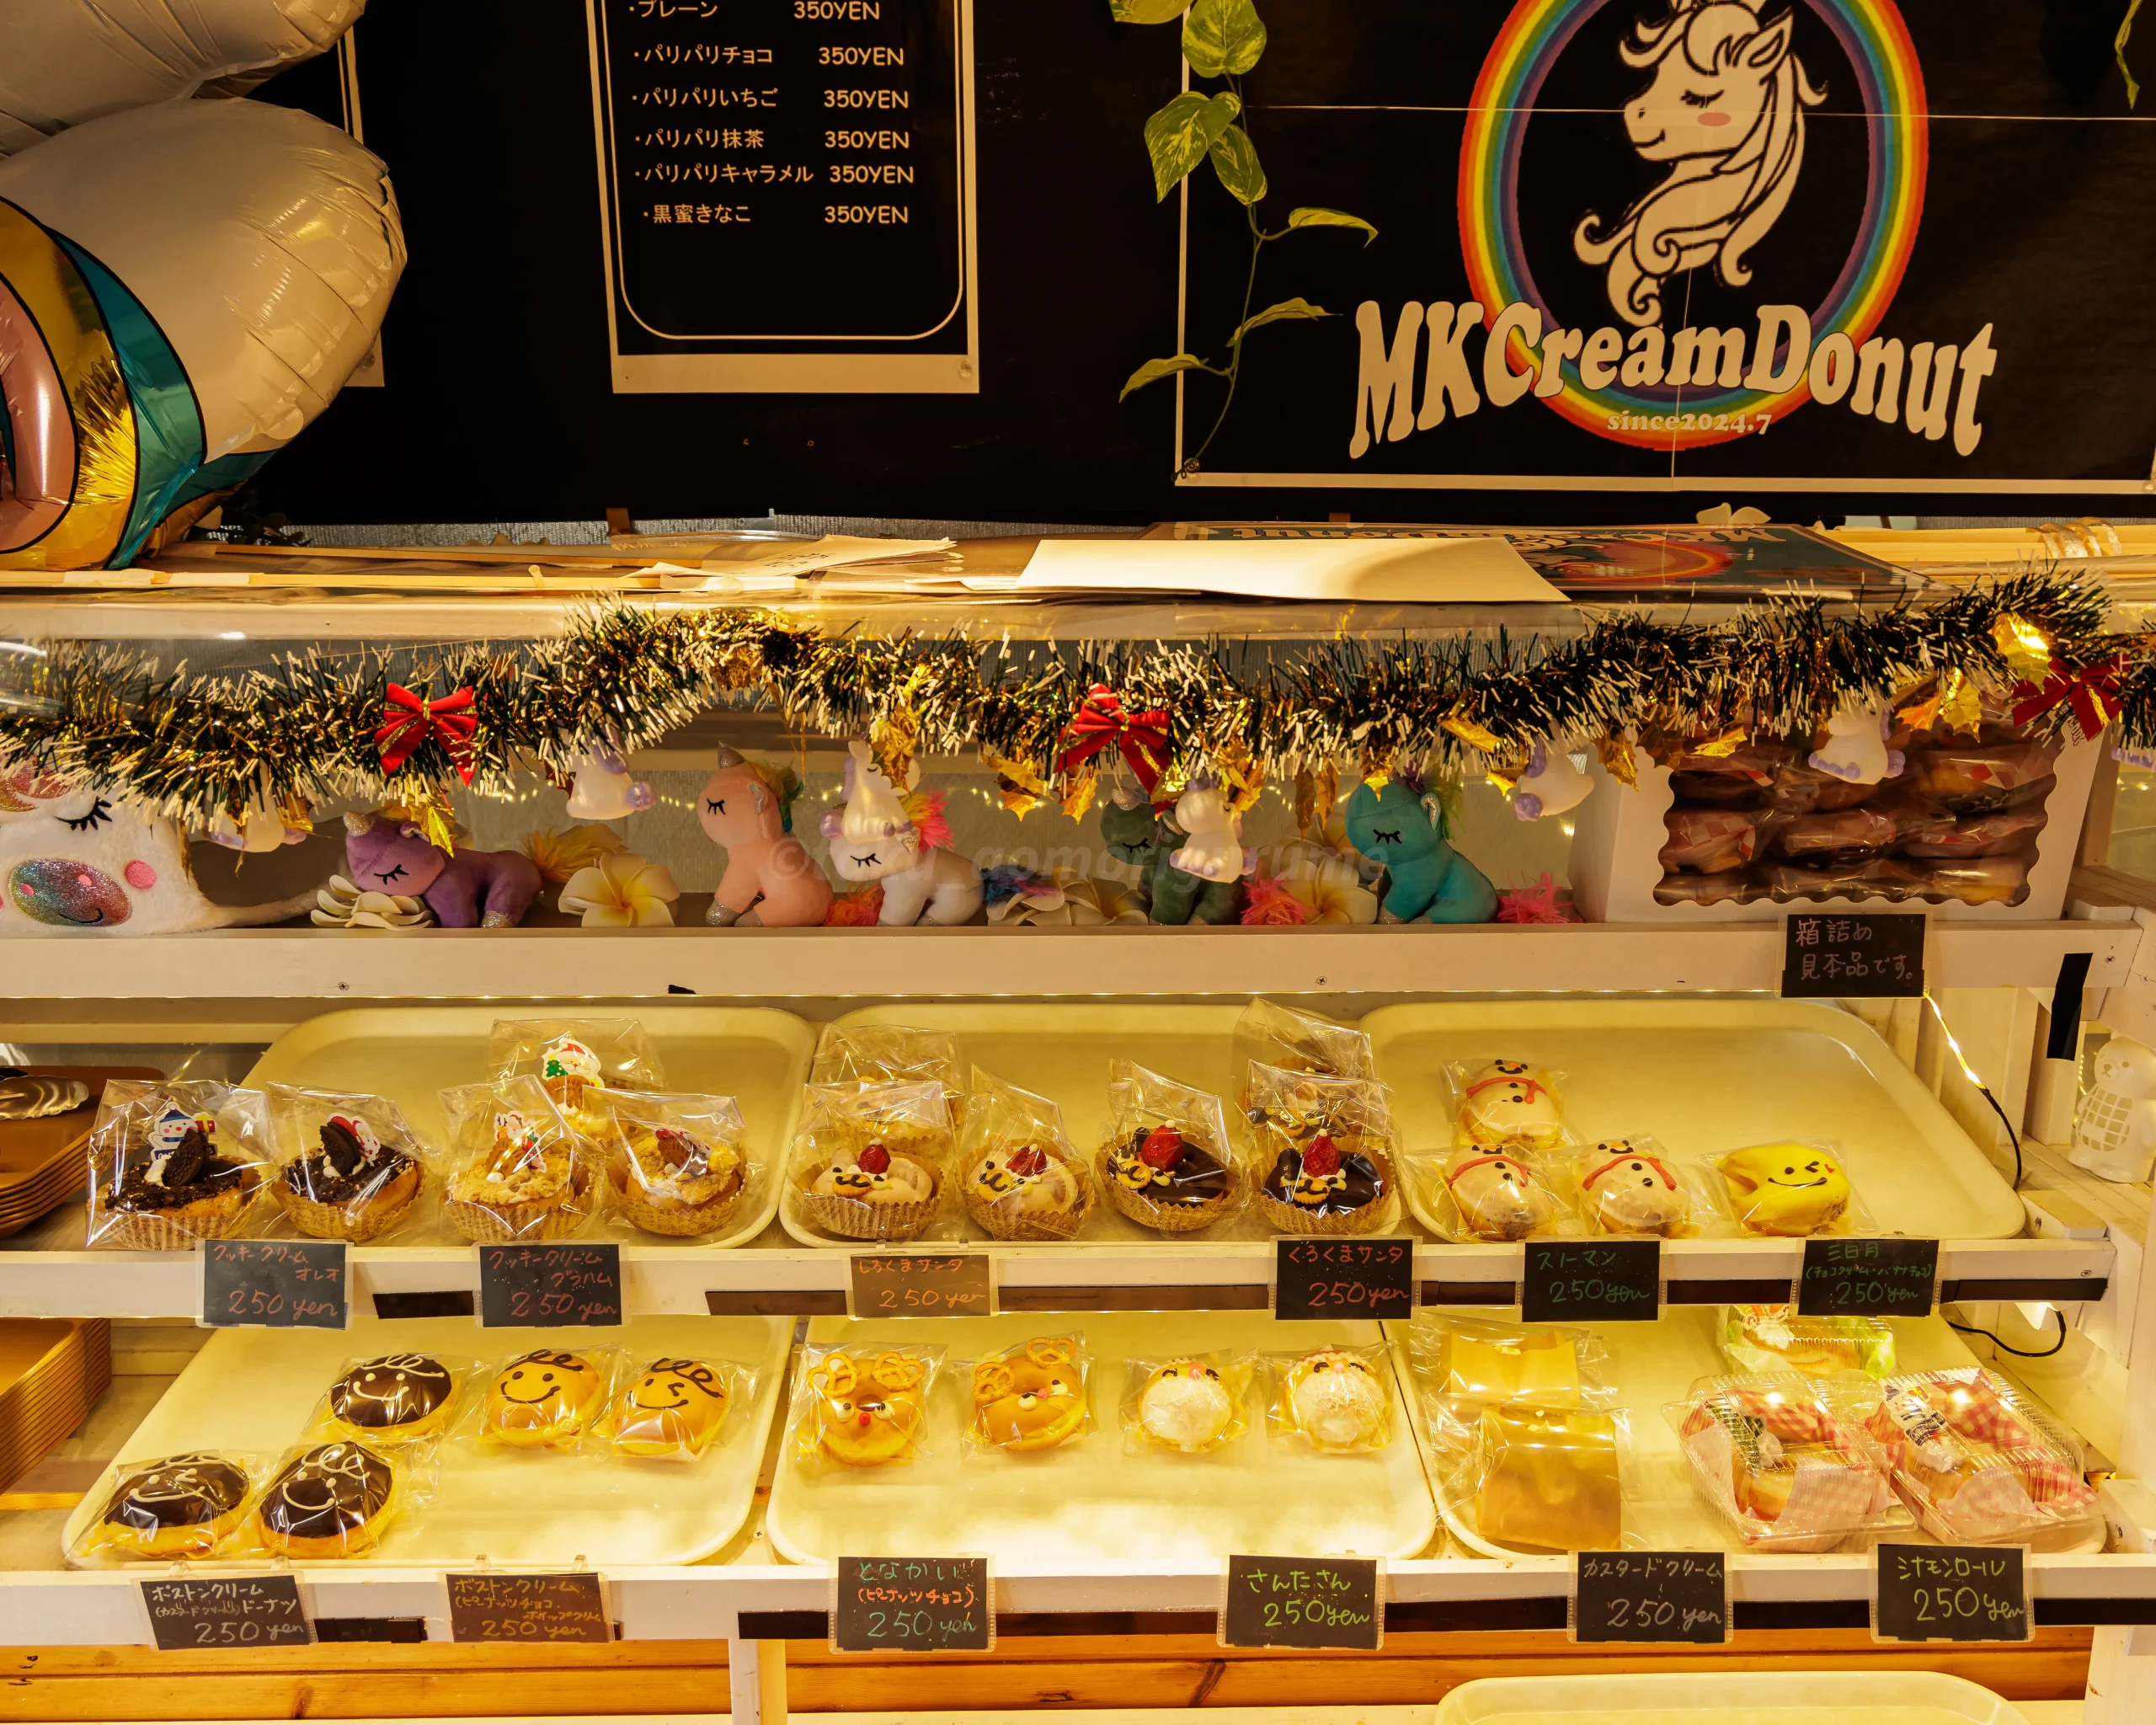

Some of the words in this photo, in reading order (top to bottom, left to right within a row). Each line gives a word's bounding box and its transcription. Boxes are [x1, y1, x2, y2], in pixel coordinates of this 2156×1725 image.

[794, 2, 879, 19] 350YEN
[819, 47, 905, 66] 350YEN
[824, 90, 909, 109] 350YEN
[825, 131, 910, 149] 350YEN
[830, 166, 914, 184] 350YEN
[825, 206, 909, 224] 350YEN
[1607, 413, 1773, 435] since2024.7
[1796, 918, 1872, 948] 箱詰め
[1289, 1244, 1403, 1264] くろくまサンタ
[1828, 1242, 1879, 1262] 三日月
[859, 1258, 963, 1274] しろくまサンタ
[1246, 1568, 1352, 1594] さんたさん
